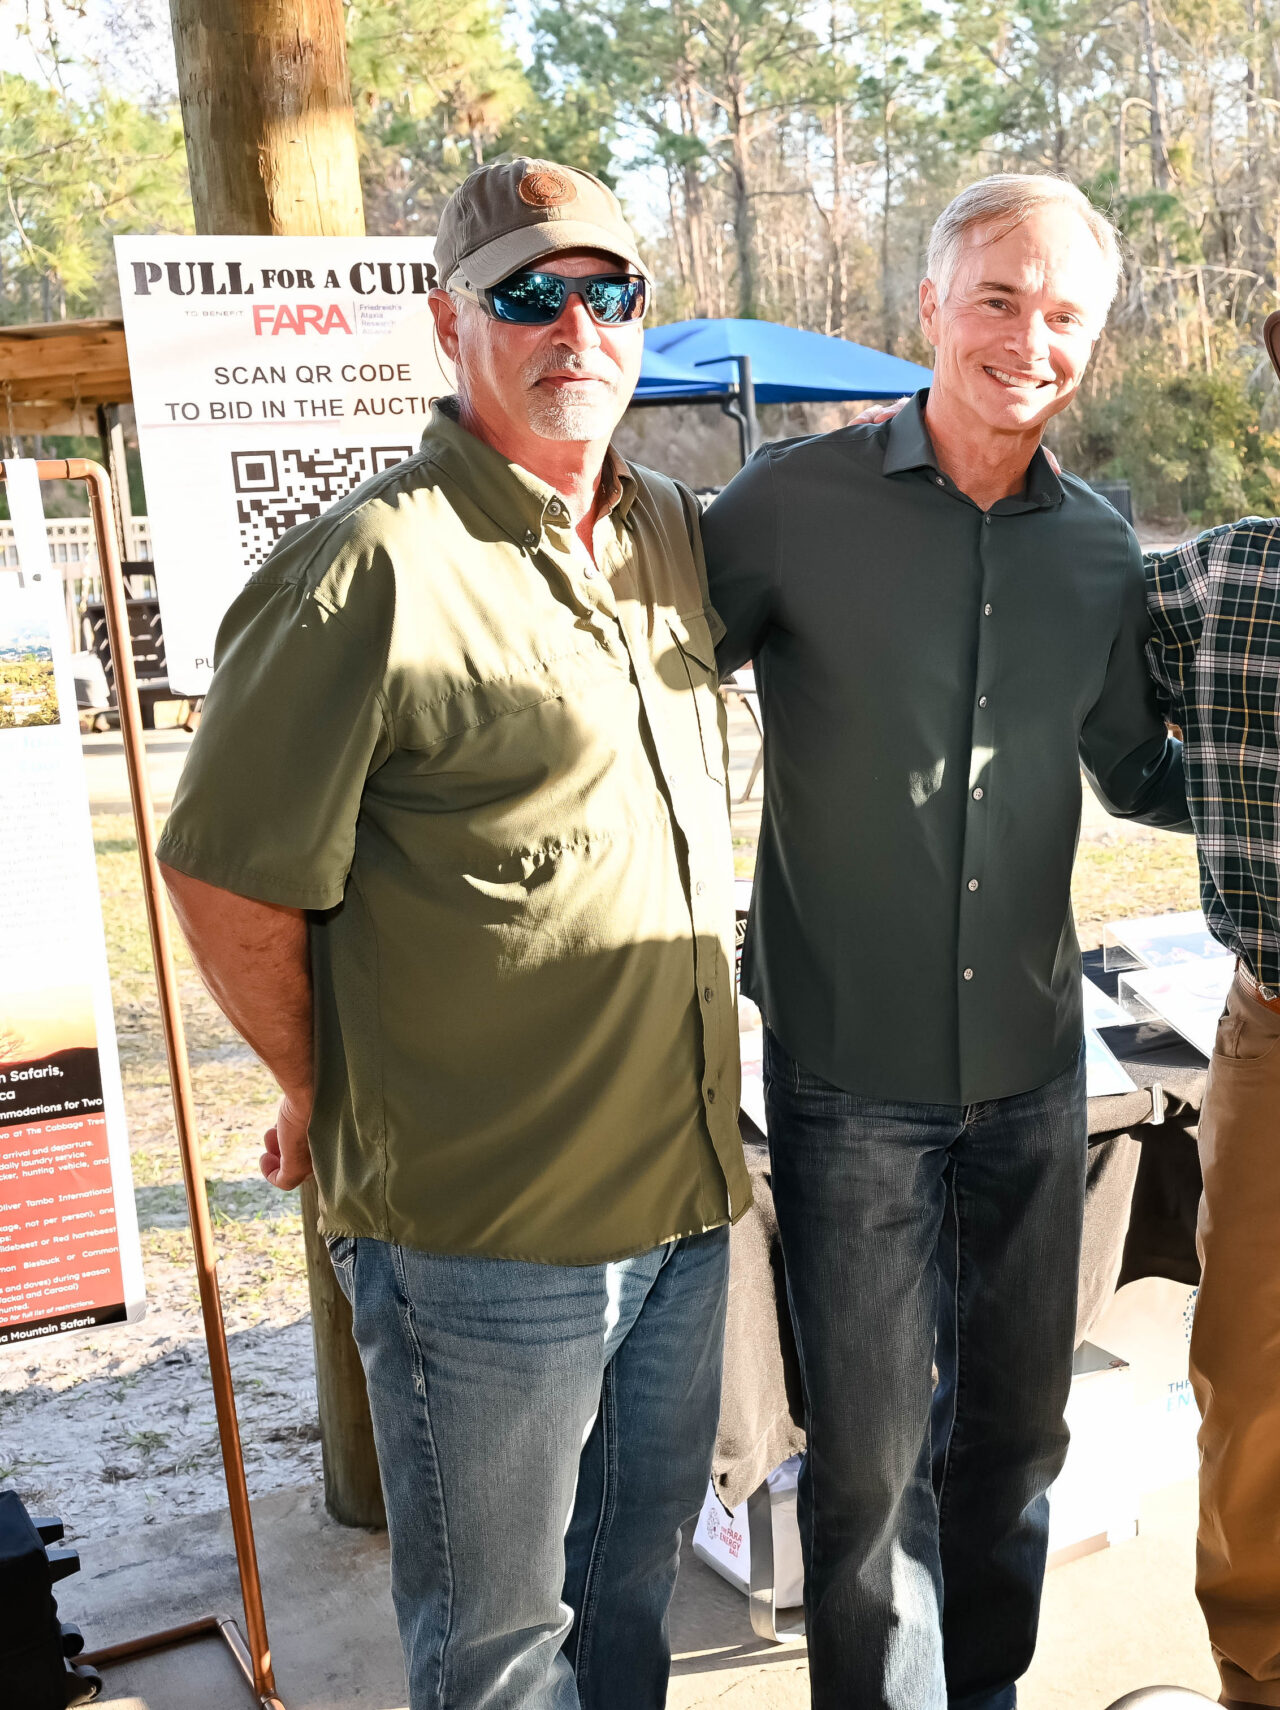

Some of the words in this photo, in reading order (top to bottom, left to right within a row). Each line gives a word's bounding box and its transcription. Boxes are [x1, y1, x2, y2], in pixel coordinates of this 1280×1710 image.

[130, 262, 254, 295] PULL
[261, 269, 315, 289] FOR
[324, 269, 341, 288] A
[252, 304, 353, 335] FARA
[214, 366, 286, 385] SCAN
[295, 365, 333, 384] QR
[341, 364, 412, 383] CODE
[165, 402, 200, 421] TO
[209, 401, 253, 420] BID
[262, 400, 286, 419] IN
[294, 399, 344, 418] THE
[10, 1064, 64, 1082] Safaris,
[64, 1100, 80, 1110] for
[81, 1098, 103, 1108] Two
[26, 1127, 42, 1136] The
[45, 1121, 84, 1133] Cabbage
[32, 1146, 49, 1156] and
[92, 1157, 110, 1166] and
[53, 1234, 70, 1244] Red
[82, 1246, 119, 1258] Common
[5, 1282, 22, 1293] and
[53, 1273, 80, 1284] during
[82, 1267, 111, 1278] season
[26, 1289, 42, 1299] and
[10, 1323, 59, 1341] Mountain
[60, 1316, 96, 1331] Safaris
